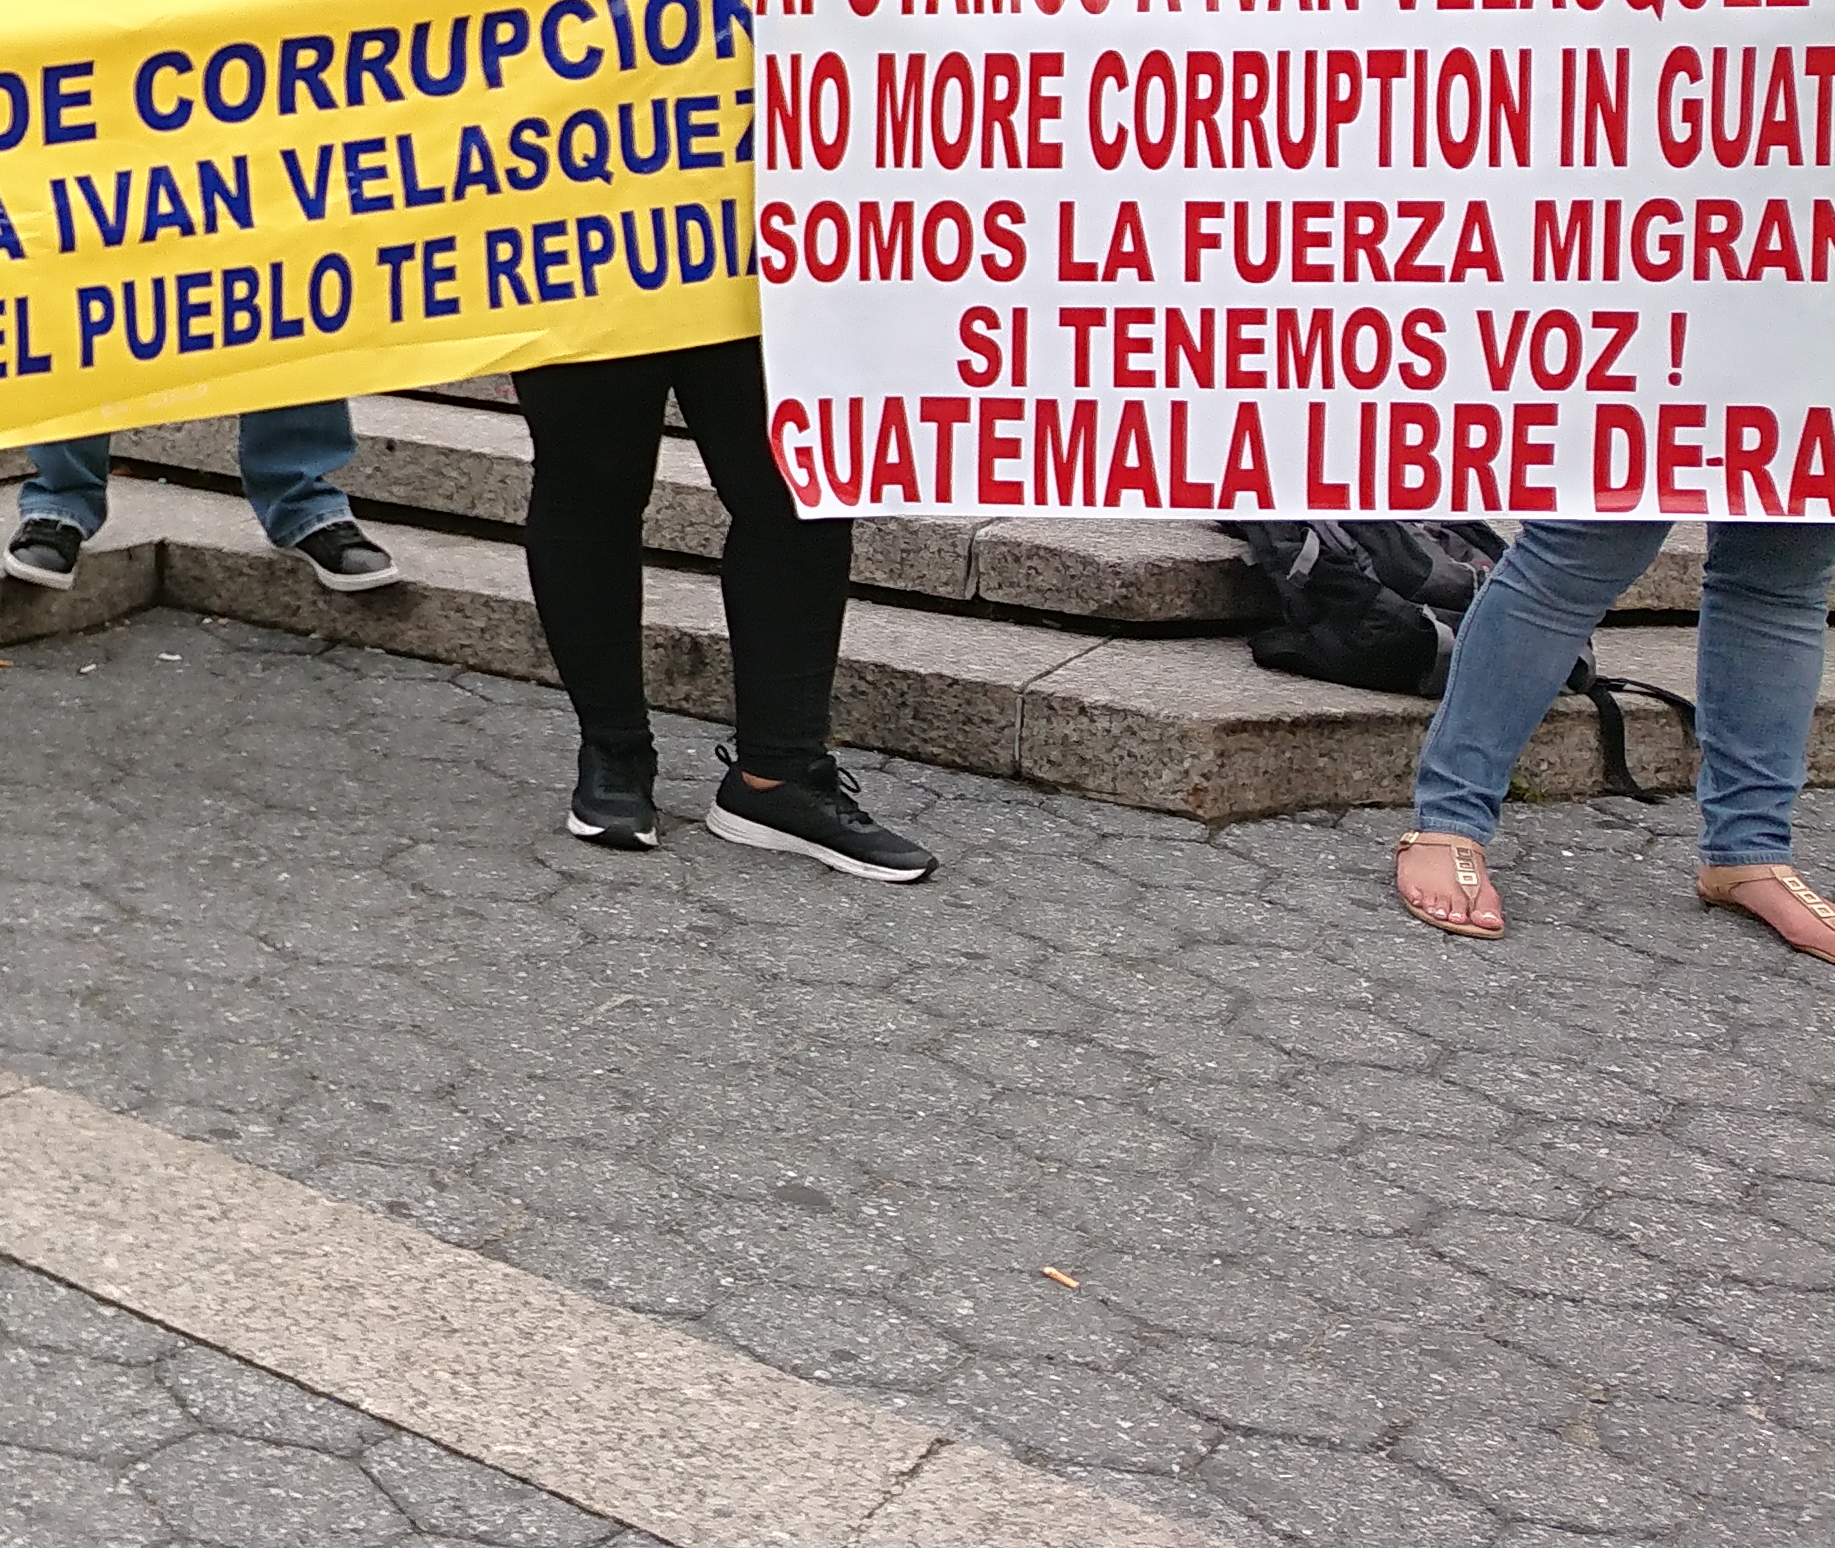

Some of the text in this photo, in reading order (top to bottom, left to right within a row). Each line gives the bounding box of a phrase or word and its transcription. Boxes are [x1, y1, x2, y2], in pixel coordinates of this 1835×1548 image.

[765, 45, 1835, 171] NO MORE CORRUPTION IN GUAT
[50, 154, 257, 254] IVAN
[759, 200, 1027, 285] SOMOS
[1059, 200, 1157, 284] LA
[1186, 200, 1505, 285] FUERZA
[78, 261, 354, 370] PUEBLO
[376, 236, 461, 324] TE
[486, 198, 758, 310] REPUDI
[957, 306, 1689, 393] SI TENEMOS VOZ !
[771, 396, 1273, 510] GUATEMALA
[1307, 401, 1559, 515] LIBRE
